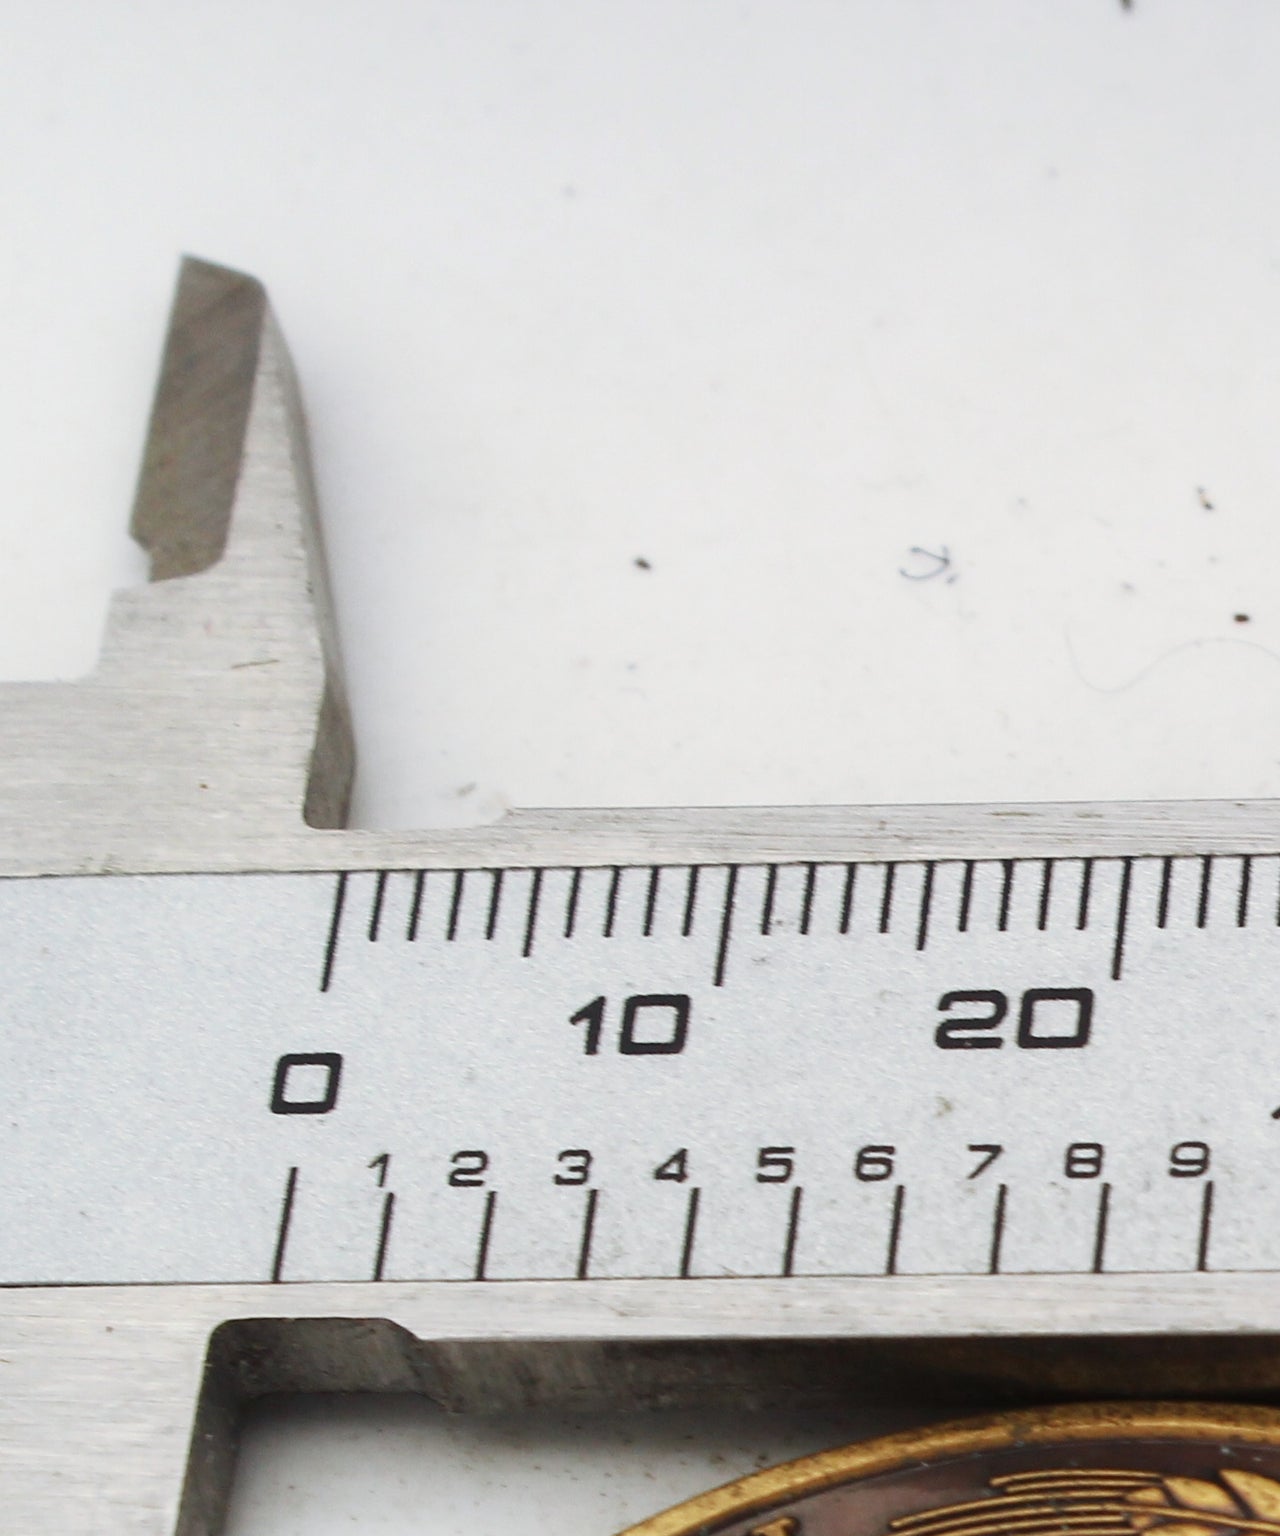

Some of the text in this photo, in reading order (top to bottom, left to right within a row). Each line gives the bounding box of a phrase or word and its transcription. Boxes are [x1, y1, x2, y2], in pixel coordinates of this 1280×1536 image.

[268, 1051, 344, 1116] 0
[568, 993, 692, 1057] 10
[933, 986, 1095, 1051] 20
[369, 1152, 391, 1188] 1
[447, 1149, 490, 1188] 2
[553, 1148, 594, 1187] 3
[653, 1148, 689, 1184] 4
[755, 1146, 796, 1184] 5
[853, 1144, 896, 1183] 6
[967, 1143, 1004, 1180] 7
[1063, 1142, 1105, 1180] 8
[1168, 1140, 1211, 1179] 9
